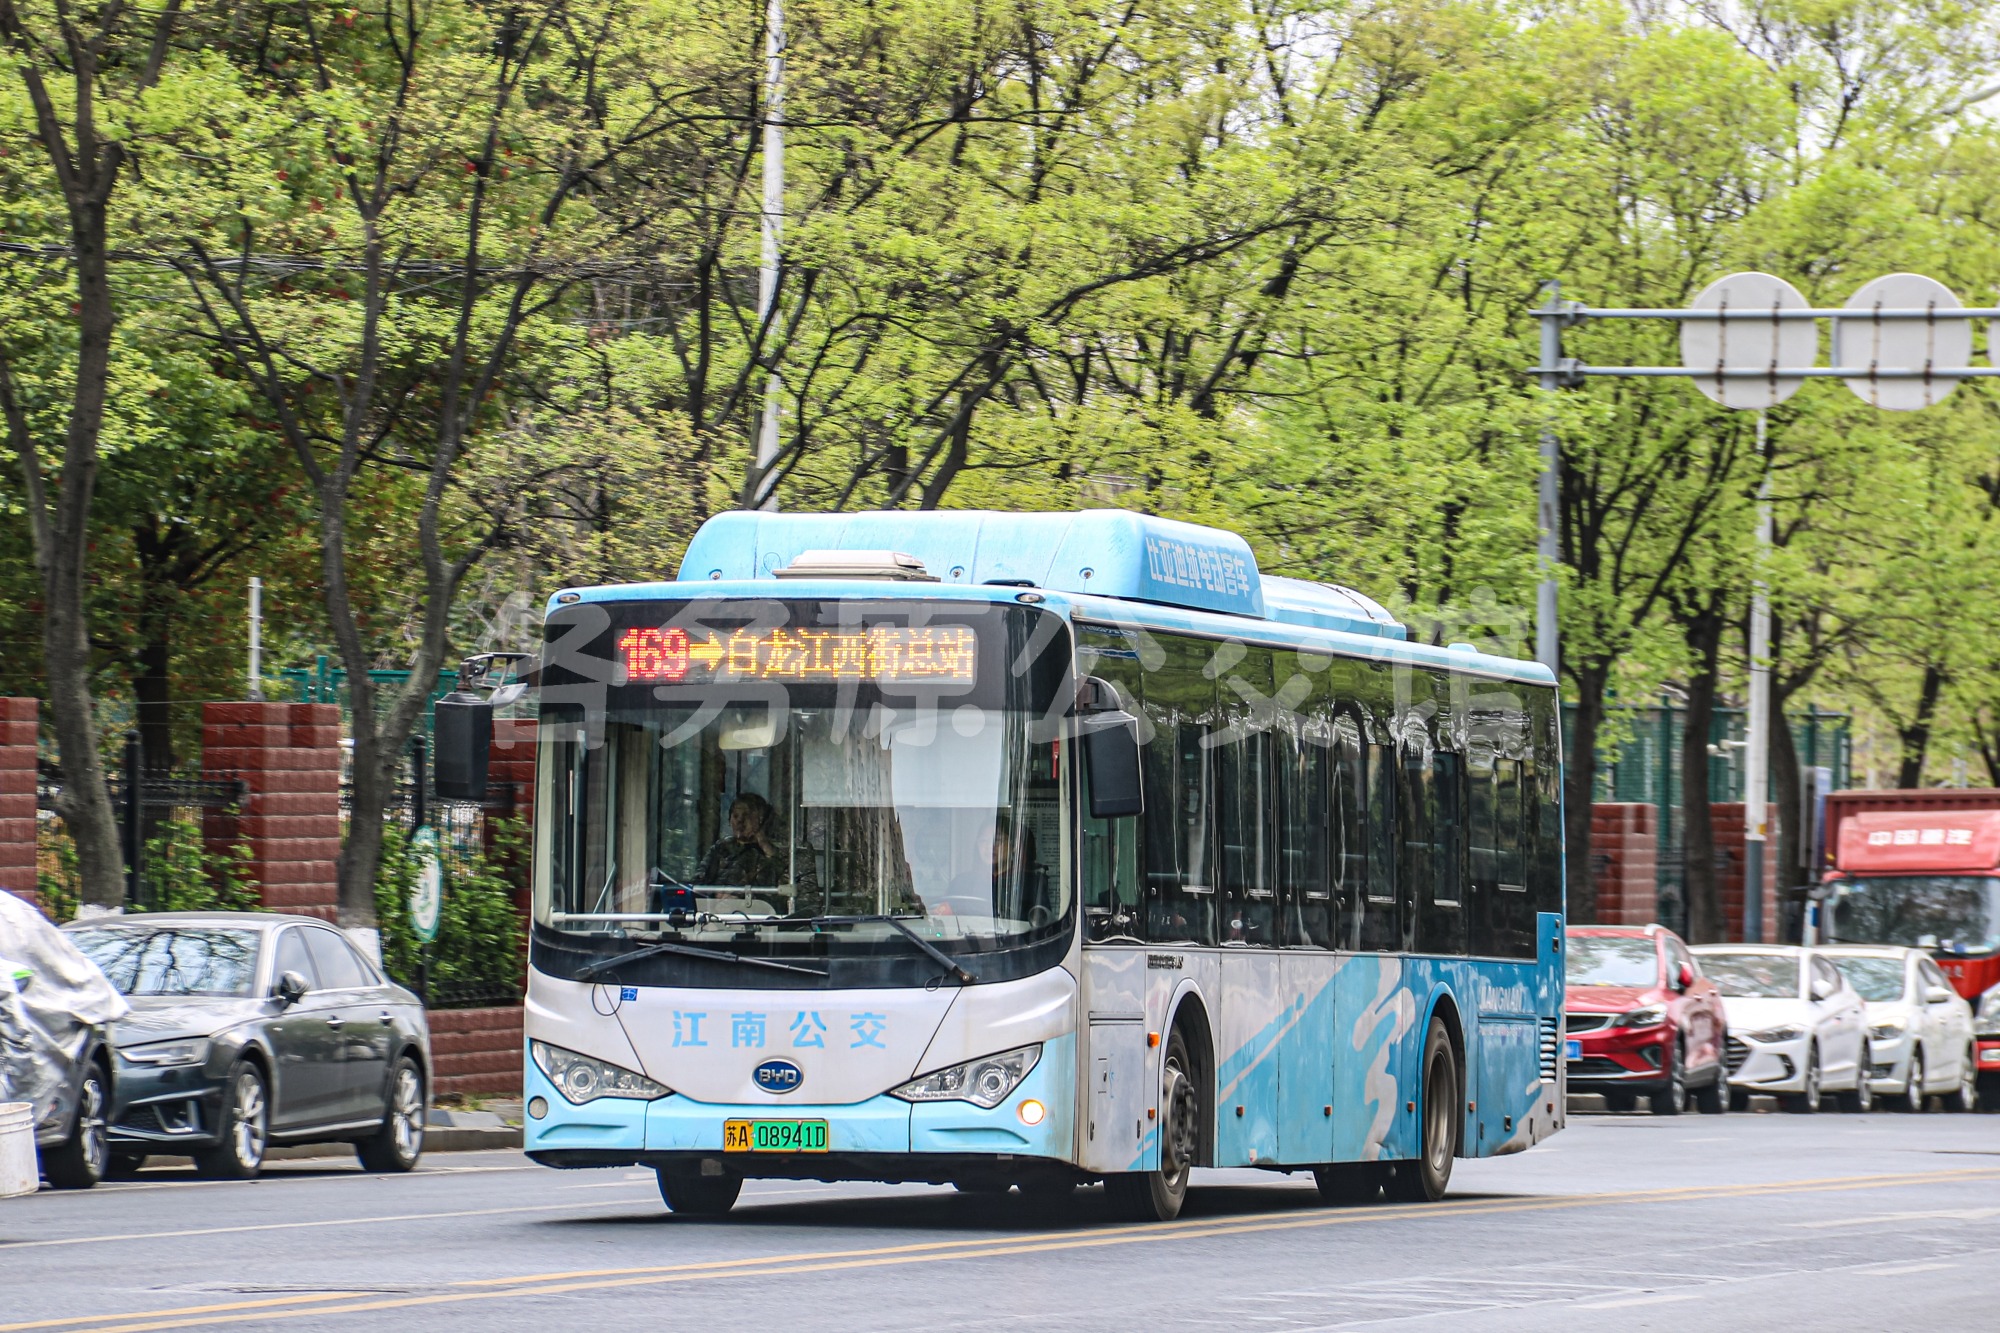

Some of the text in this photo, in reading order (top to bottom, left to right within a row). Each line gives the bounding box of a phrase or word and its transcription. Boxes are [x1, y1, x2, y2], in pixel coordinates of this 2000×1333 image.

[1145, 536, 1250, 598] 比亚迪纯电动客车
[619, 628, 975, 678] 169 白龙江西街总站
[672, 1010, 886, 1048] 江南公交
[759, 1068, 797, 1083] BYD
